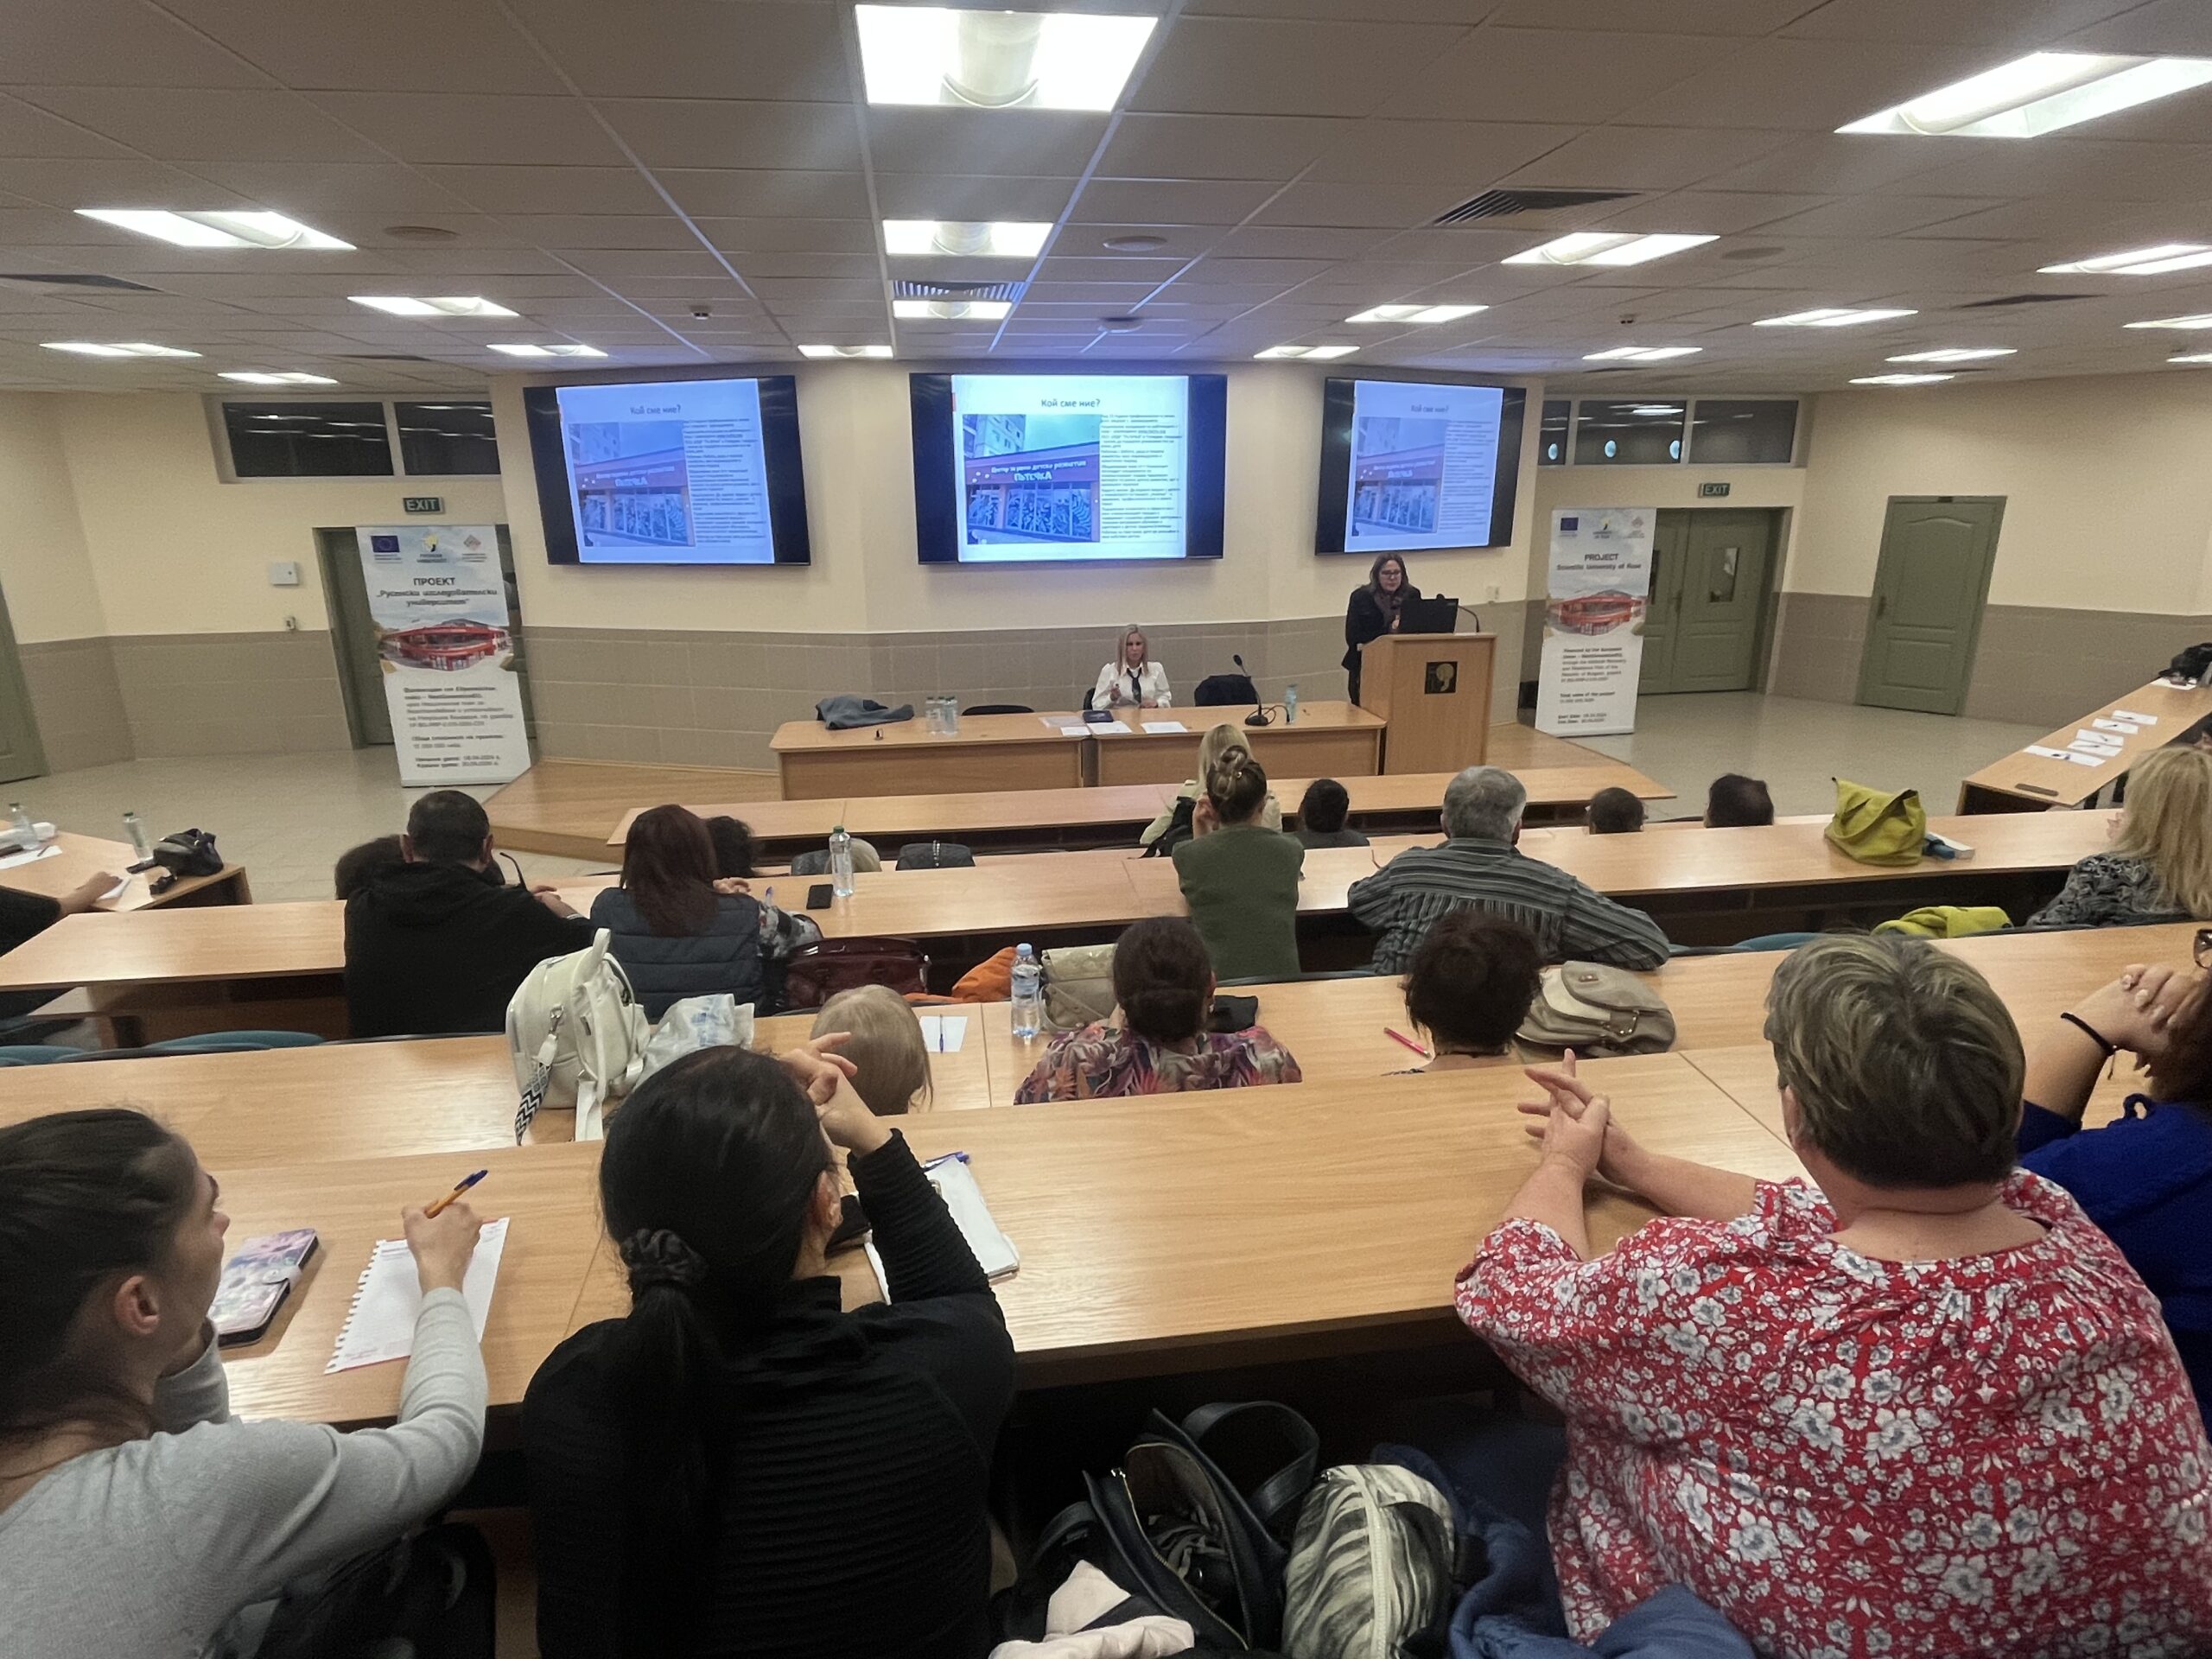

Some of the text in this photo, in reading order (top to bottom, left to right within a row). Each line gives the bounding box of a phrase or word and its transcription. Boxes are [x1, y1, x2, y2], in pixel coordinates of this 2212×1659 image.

[1041, 398, 1058, 408] Кой
[1079, 398, 1101, 408] ние?
[630, 405, 645, 415] Кой
[1704, 485, 1728, 495] EXIT
[406, 499, 436, 511] EXIT
[1585, 553, 1619, 562] PROJECT
[413, 577, 456, 587] ПРОЕКТ
